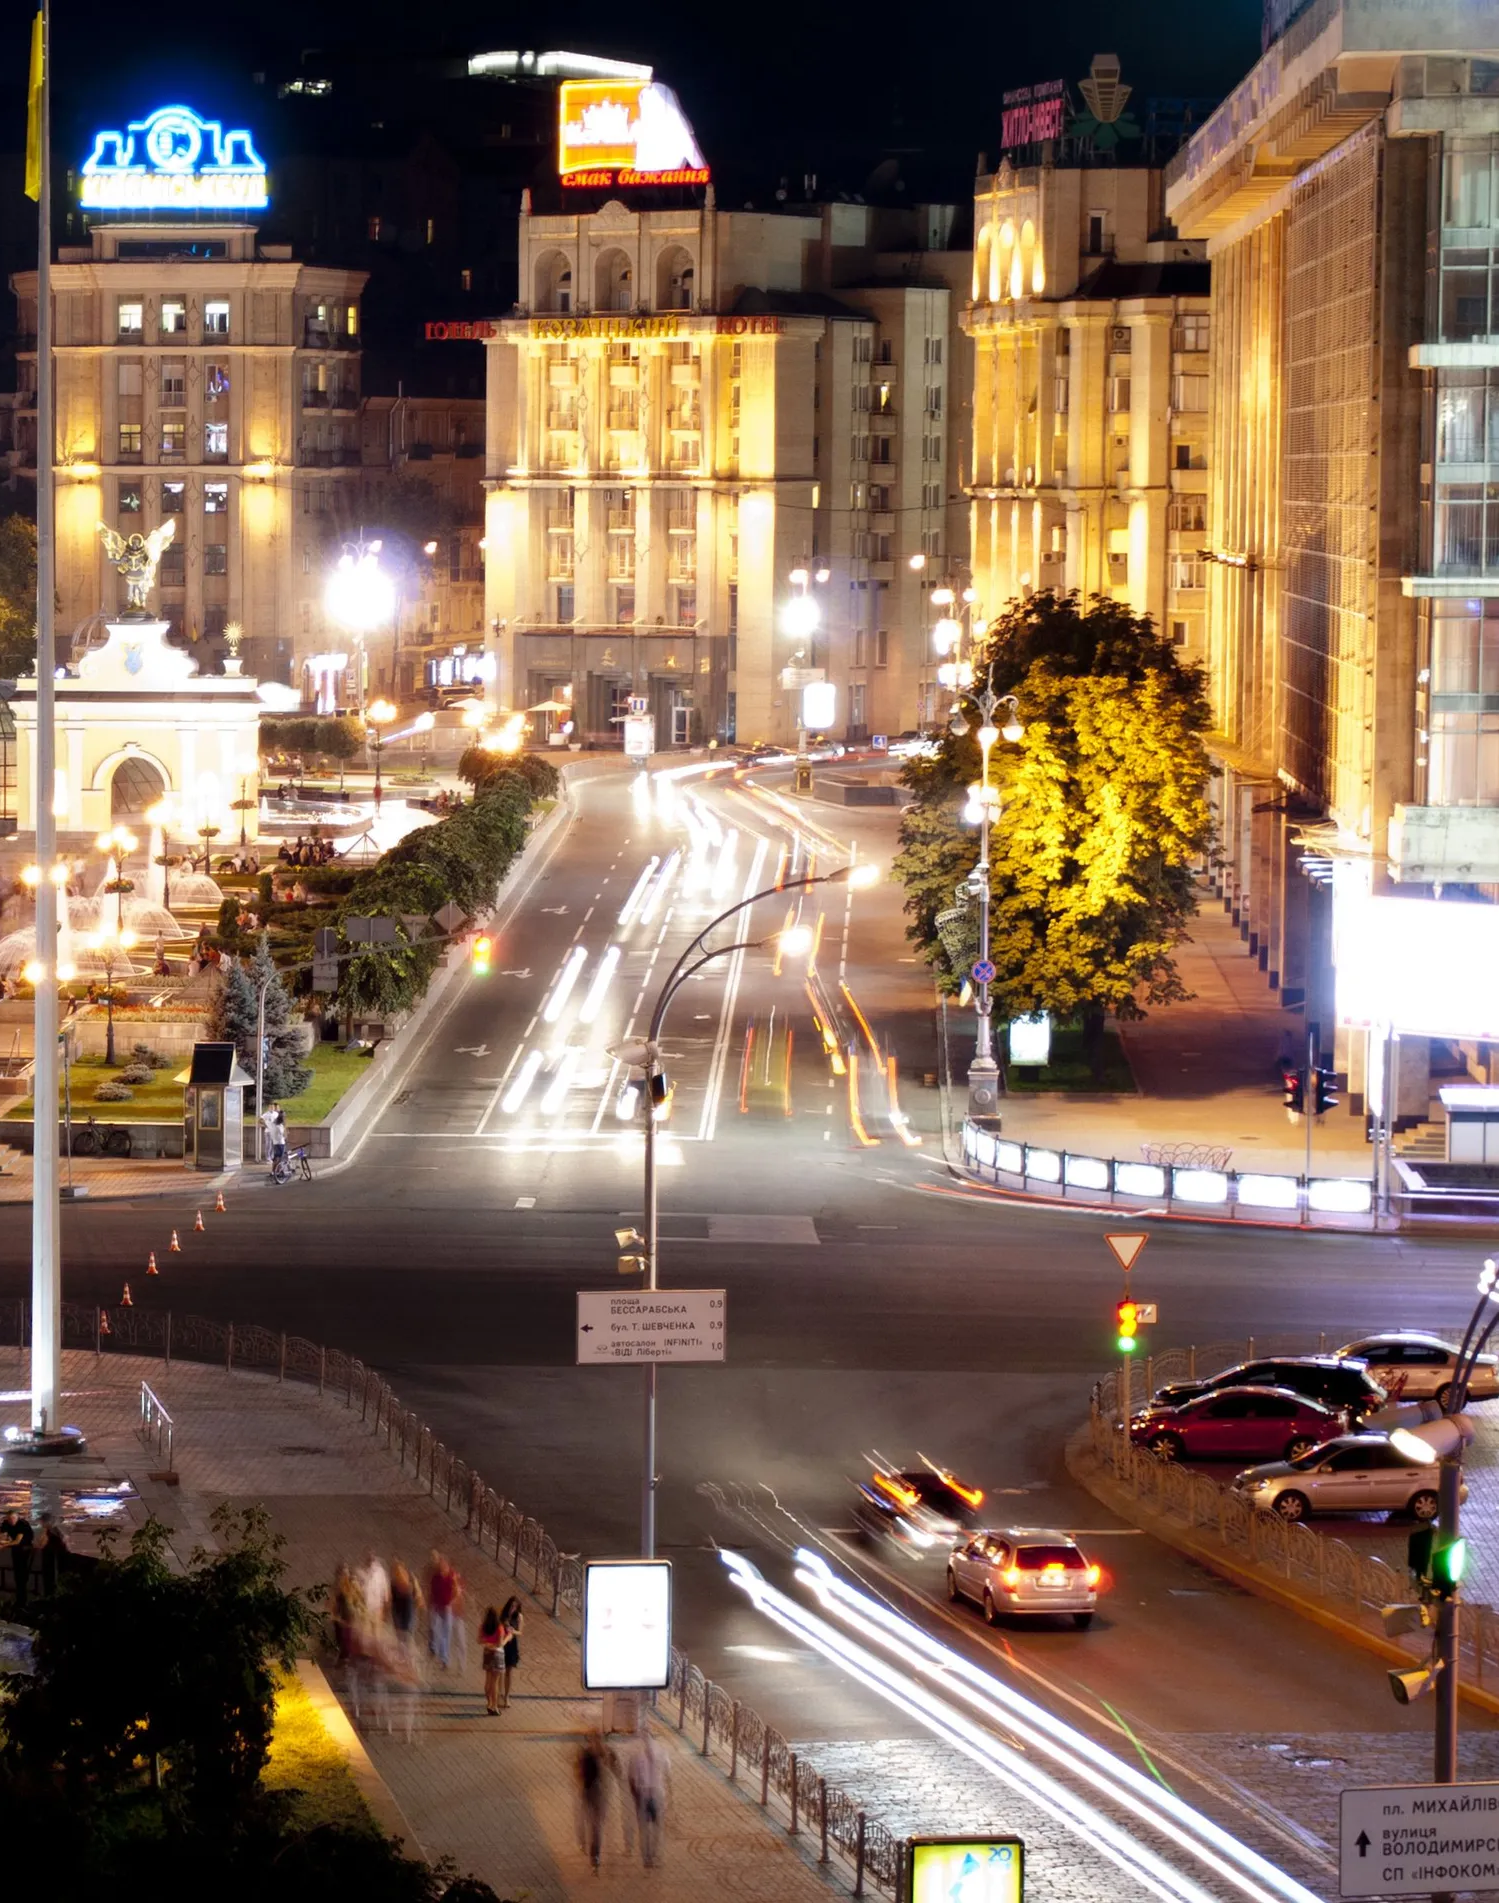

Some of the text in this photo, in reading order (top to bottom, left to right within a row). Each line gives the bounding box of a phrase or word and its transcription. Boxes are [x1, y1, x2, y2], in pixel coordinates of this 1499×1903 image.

[425, 314, 679, 342] ГОТЕЛЬ КОЗАЦЬКИЙ
[716, 315, 781, 335] HOTEL
[611, 1305, 687, 1315] БЕССАРАБСЬКА
[611, 1321, 696, 1333] бул. Т. ШЕВЧЕНКА
[611, 1340, 656, 1348] автосалон
[1382, 1794, 1499, 1816] пл. МИХАЙЛІВ
[1382, 1827, 1437, 1842] вулиця
[1382, 1837, 1499, 1856] ВОЛОДИМИРС
[1382, 1867, 1404, 1881] СП
